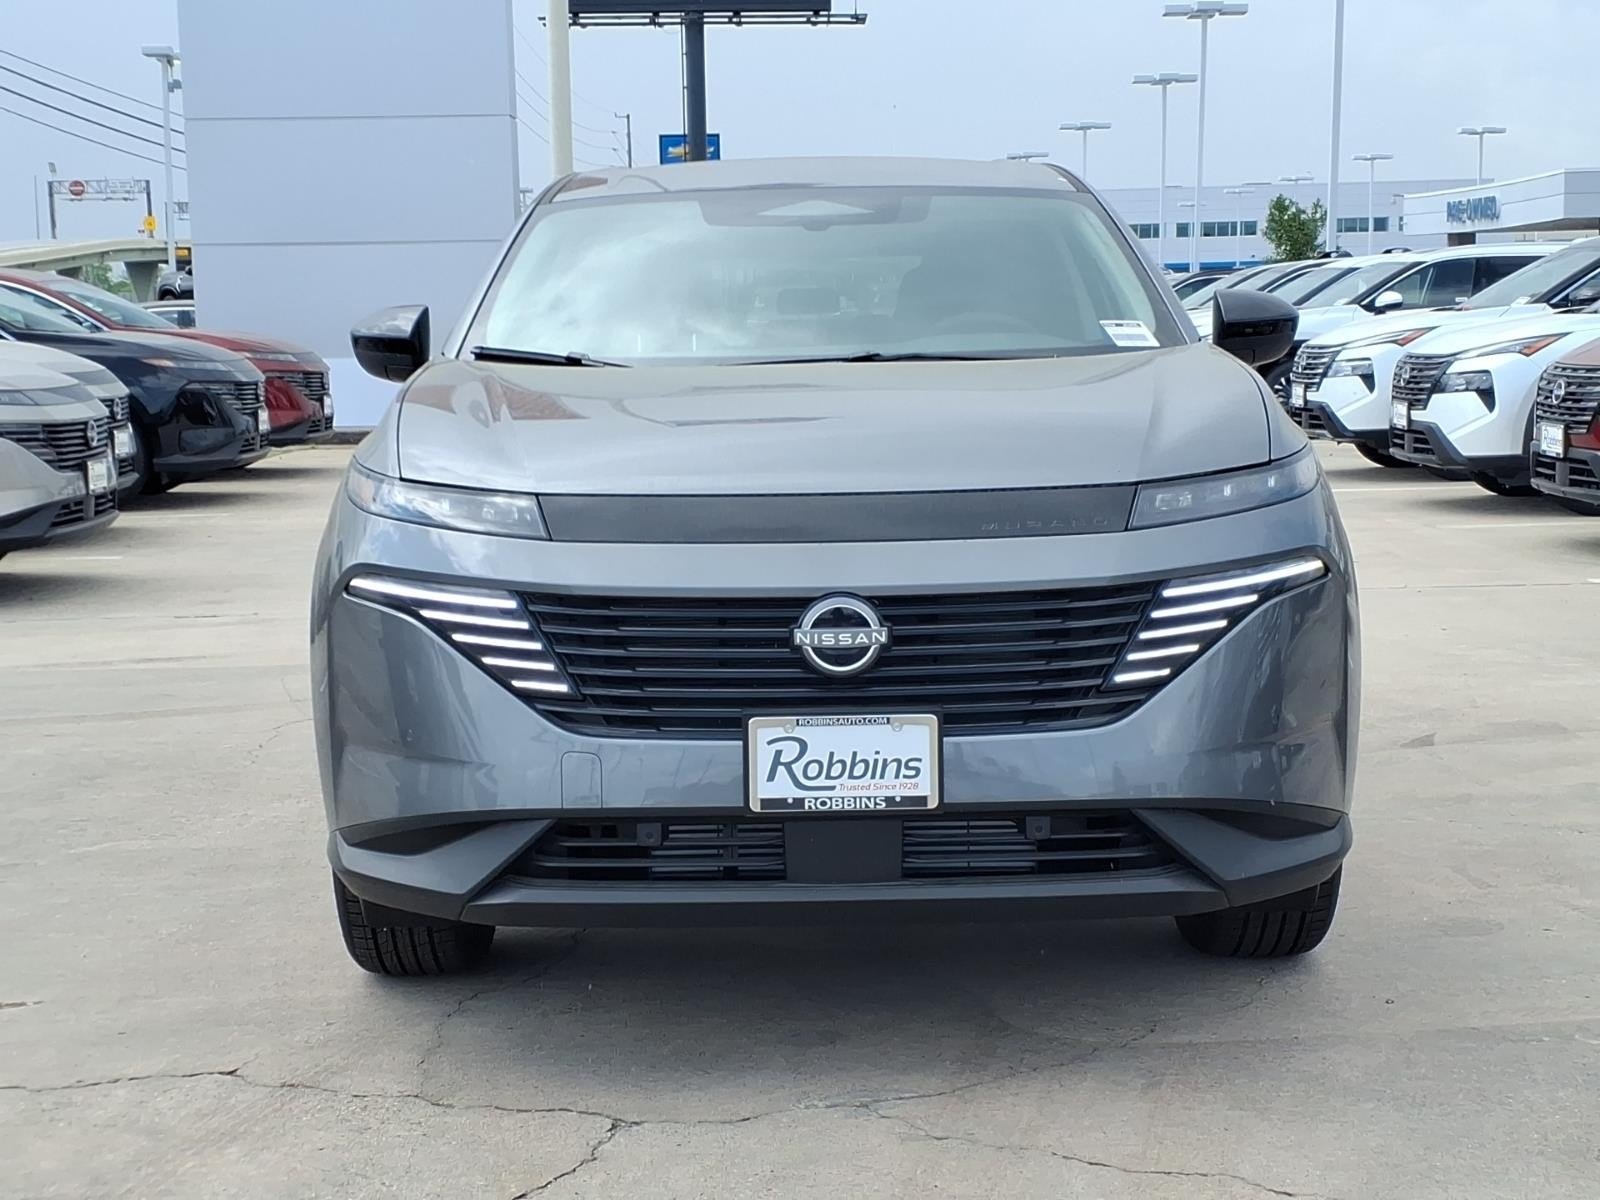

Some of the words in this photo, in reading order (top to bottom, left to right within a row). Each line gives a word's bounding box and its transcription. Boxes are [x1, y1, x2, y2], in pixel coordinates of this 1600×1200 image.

[796, 631, 887, 645] NISSAN
[798, 717, 888, 727] ROBBINSAUTO.COM
[766, 736, 922, 791] Robbins
[839, 783, 871, 792] Trusted
[872, 782, 897, 791] Since
[899, 782, 919, 791] 1928
[804, 796, 887, 810] ROBBINS
